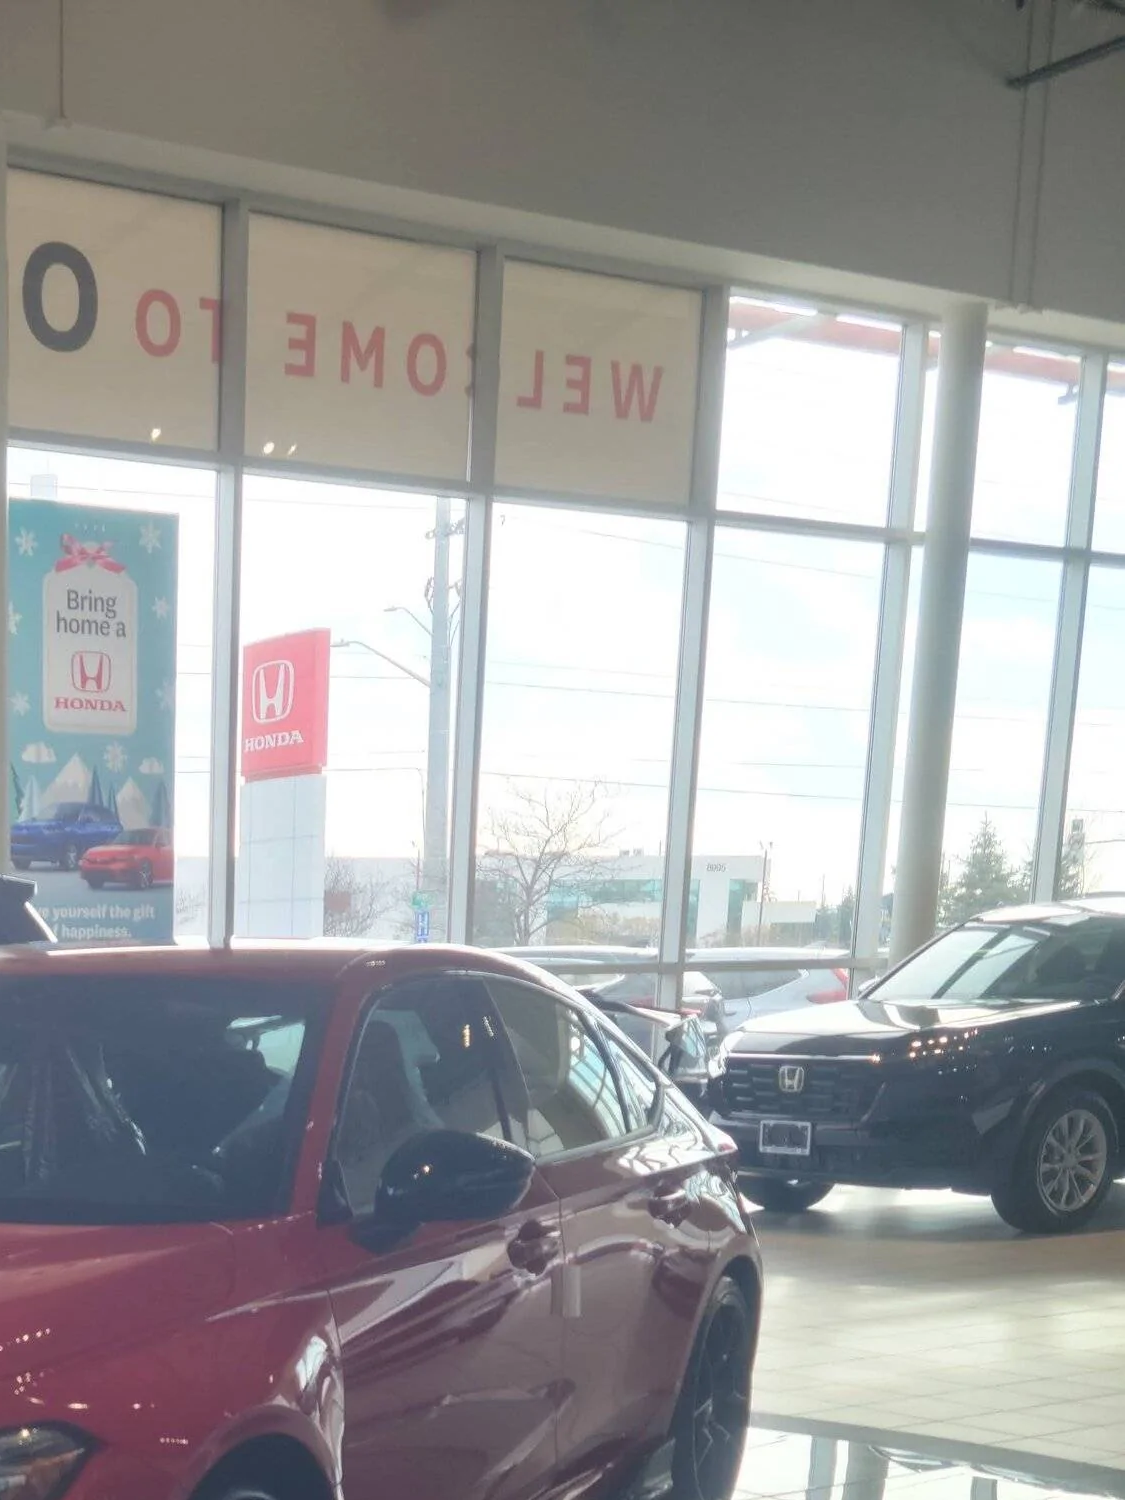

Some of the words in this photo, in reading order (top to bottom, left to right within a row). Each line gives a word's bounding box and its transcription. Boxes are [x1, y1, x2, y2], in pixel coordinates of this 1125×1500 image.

[66, 588, 117, 619] Bring
[56, 610, 111, 637] home
[116, 621, 127, 638] a
[54, 696, 127, 712] HONDA
[243, 729, 304, 753] HONDA
[52, 903, 107, 921] yourself
[109, 904, 131, 919] the
[132, 904, 156, 922] gift
